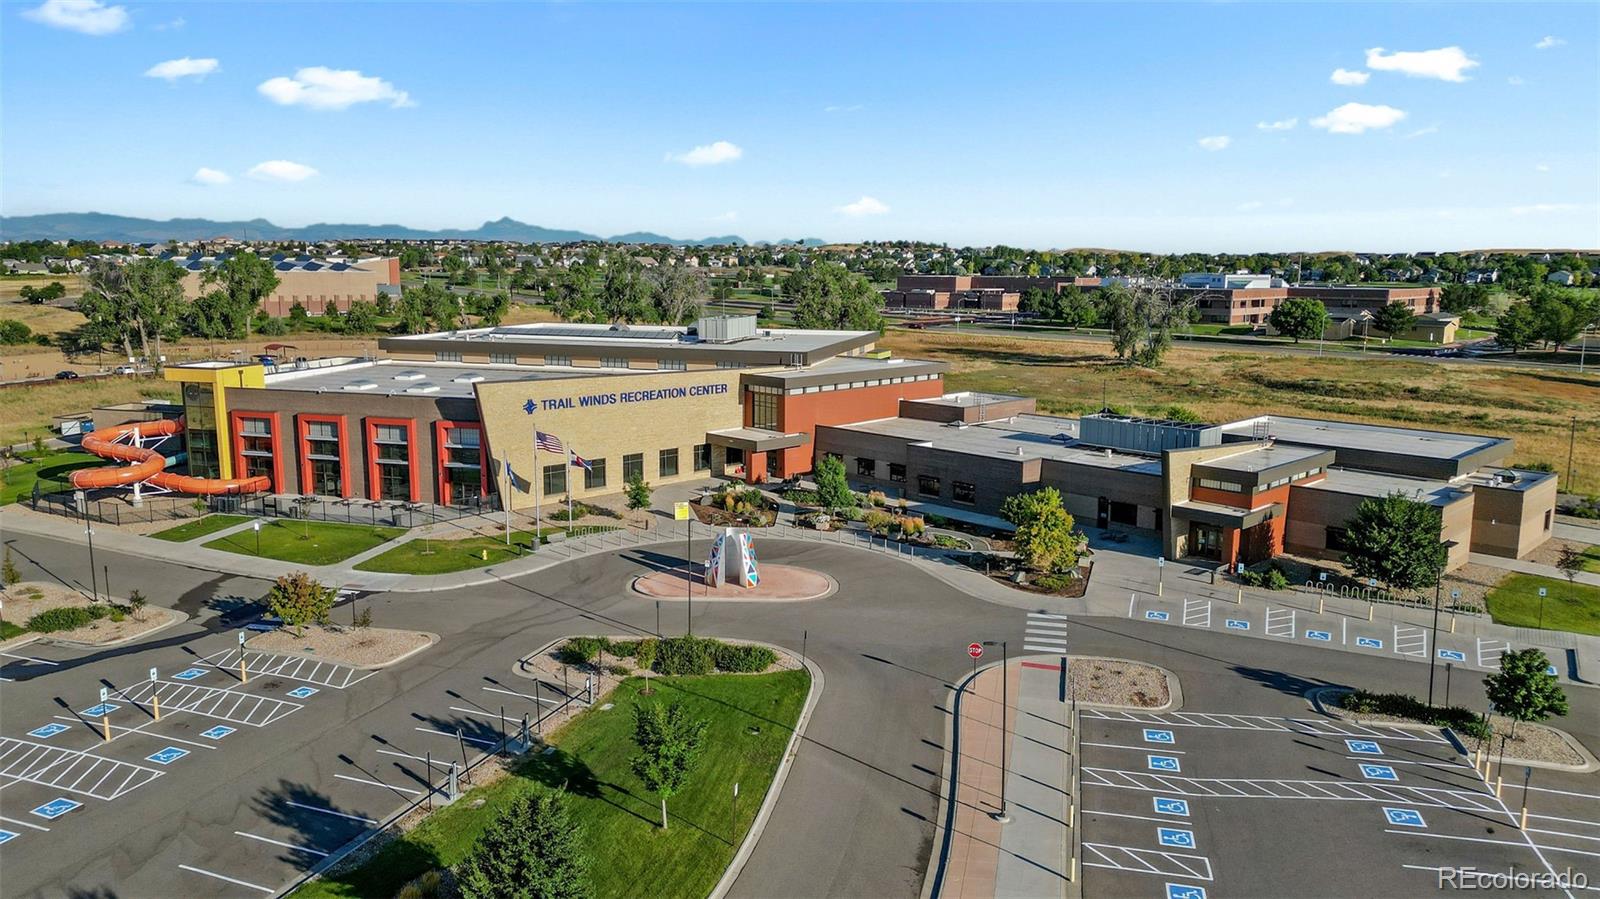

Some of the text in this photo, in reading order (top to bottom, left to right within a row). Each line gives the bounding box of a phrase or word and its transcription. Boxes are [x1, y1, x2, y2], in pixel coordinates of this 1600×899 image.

[541, 383, 728, 411] TRAIL WINDS RECREATION CENTER
